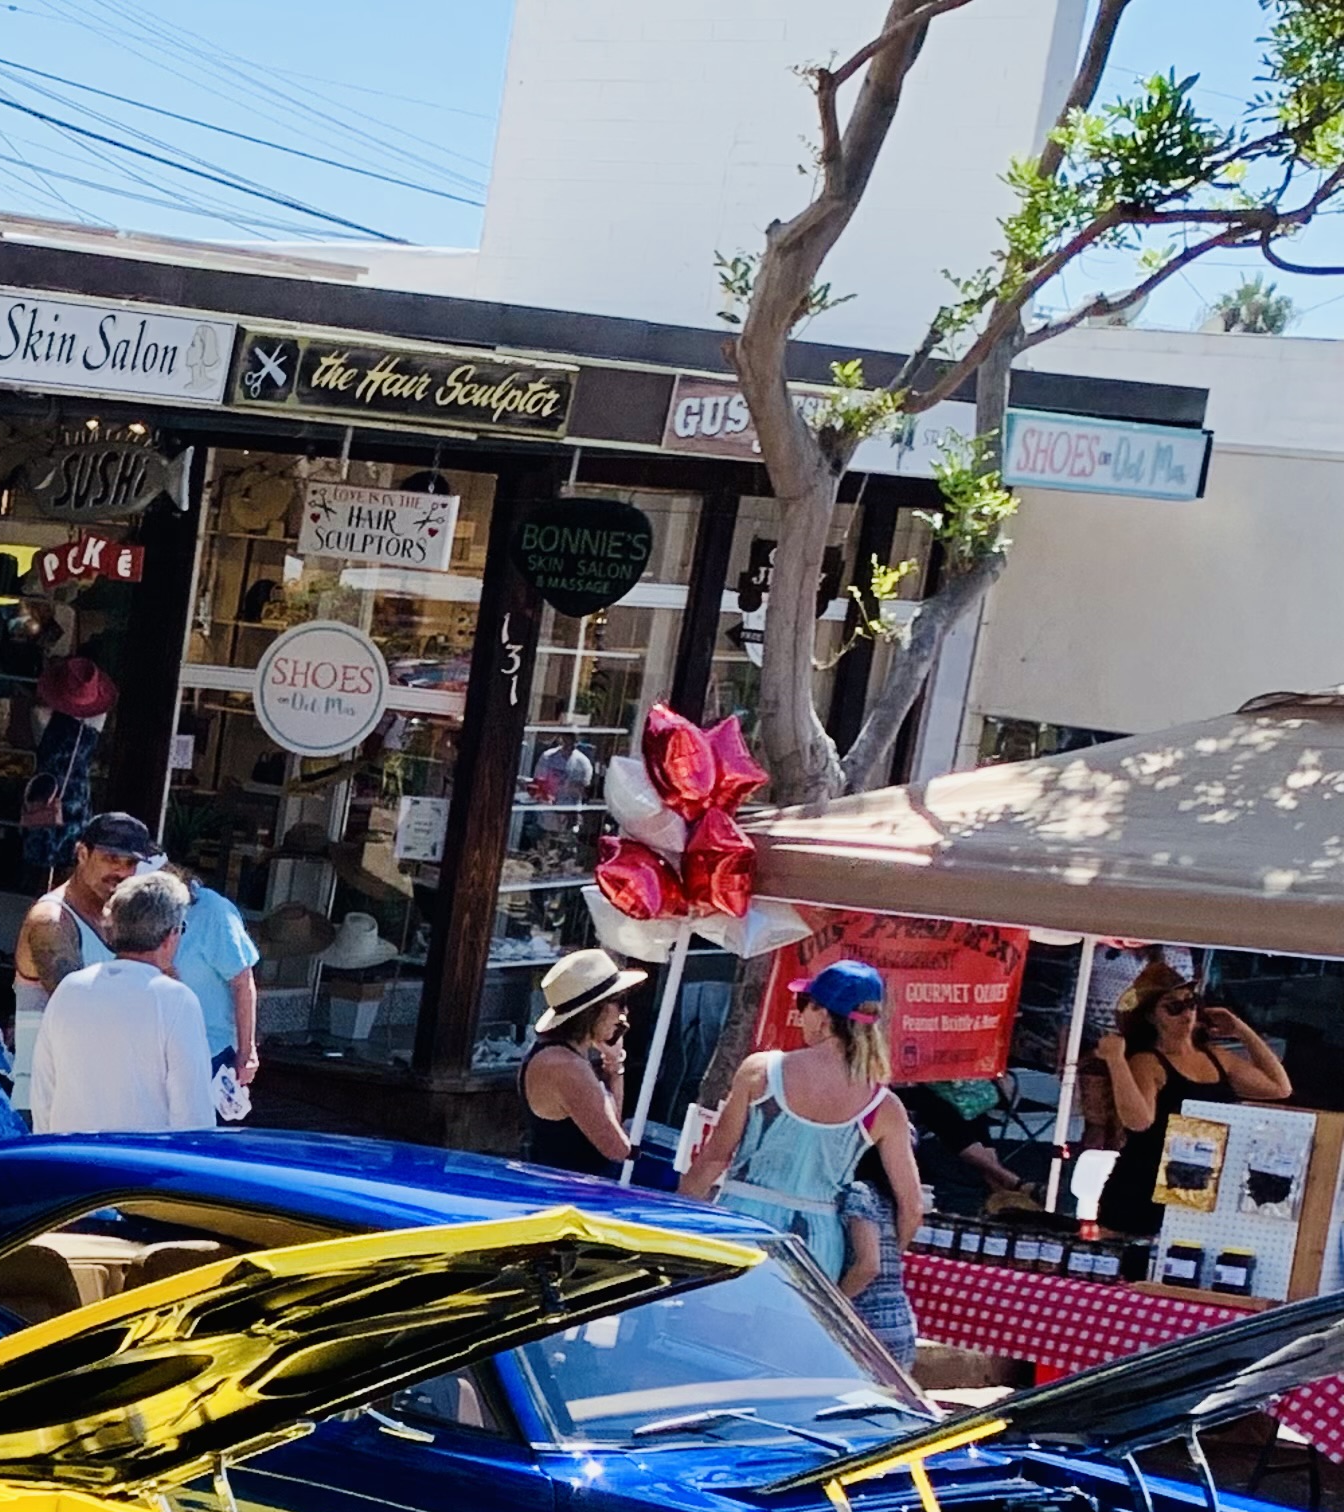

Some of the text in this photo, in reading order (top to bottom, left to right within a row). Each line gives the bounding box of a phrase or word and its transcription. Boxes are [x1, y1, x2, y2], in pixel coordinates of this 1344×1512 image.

[82, 314, 178, 376] Salon
[312, 350, 561, 422] the Hair Sculptor
[1016, 427, 1101, 478] SHOES
[347, 505, 405, 537] HAIR
[312, 526, 428, 564] SCULPTORS
[521, 523, 650, 561] BONNIE'S
[527, 554, 634, 580] SKIN SALON
[546, 577, 612, 595] MASSAGE
[271, 657, 374, 695] SHOES
[905, 983, 970, 1004] GOURMET
